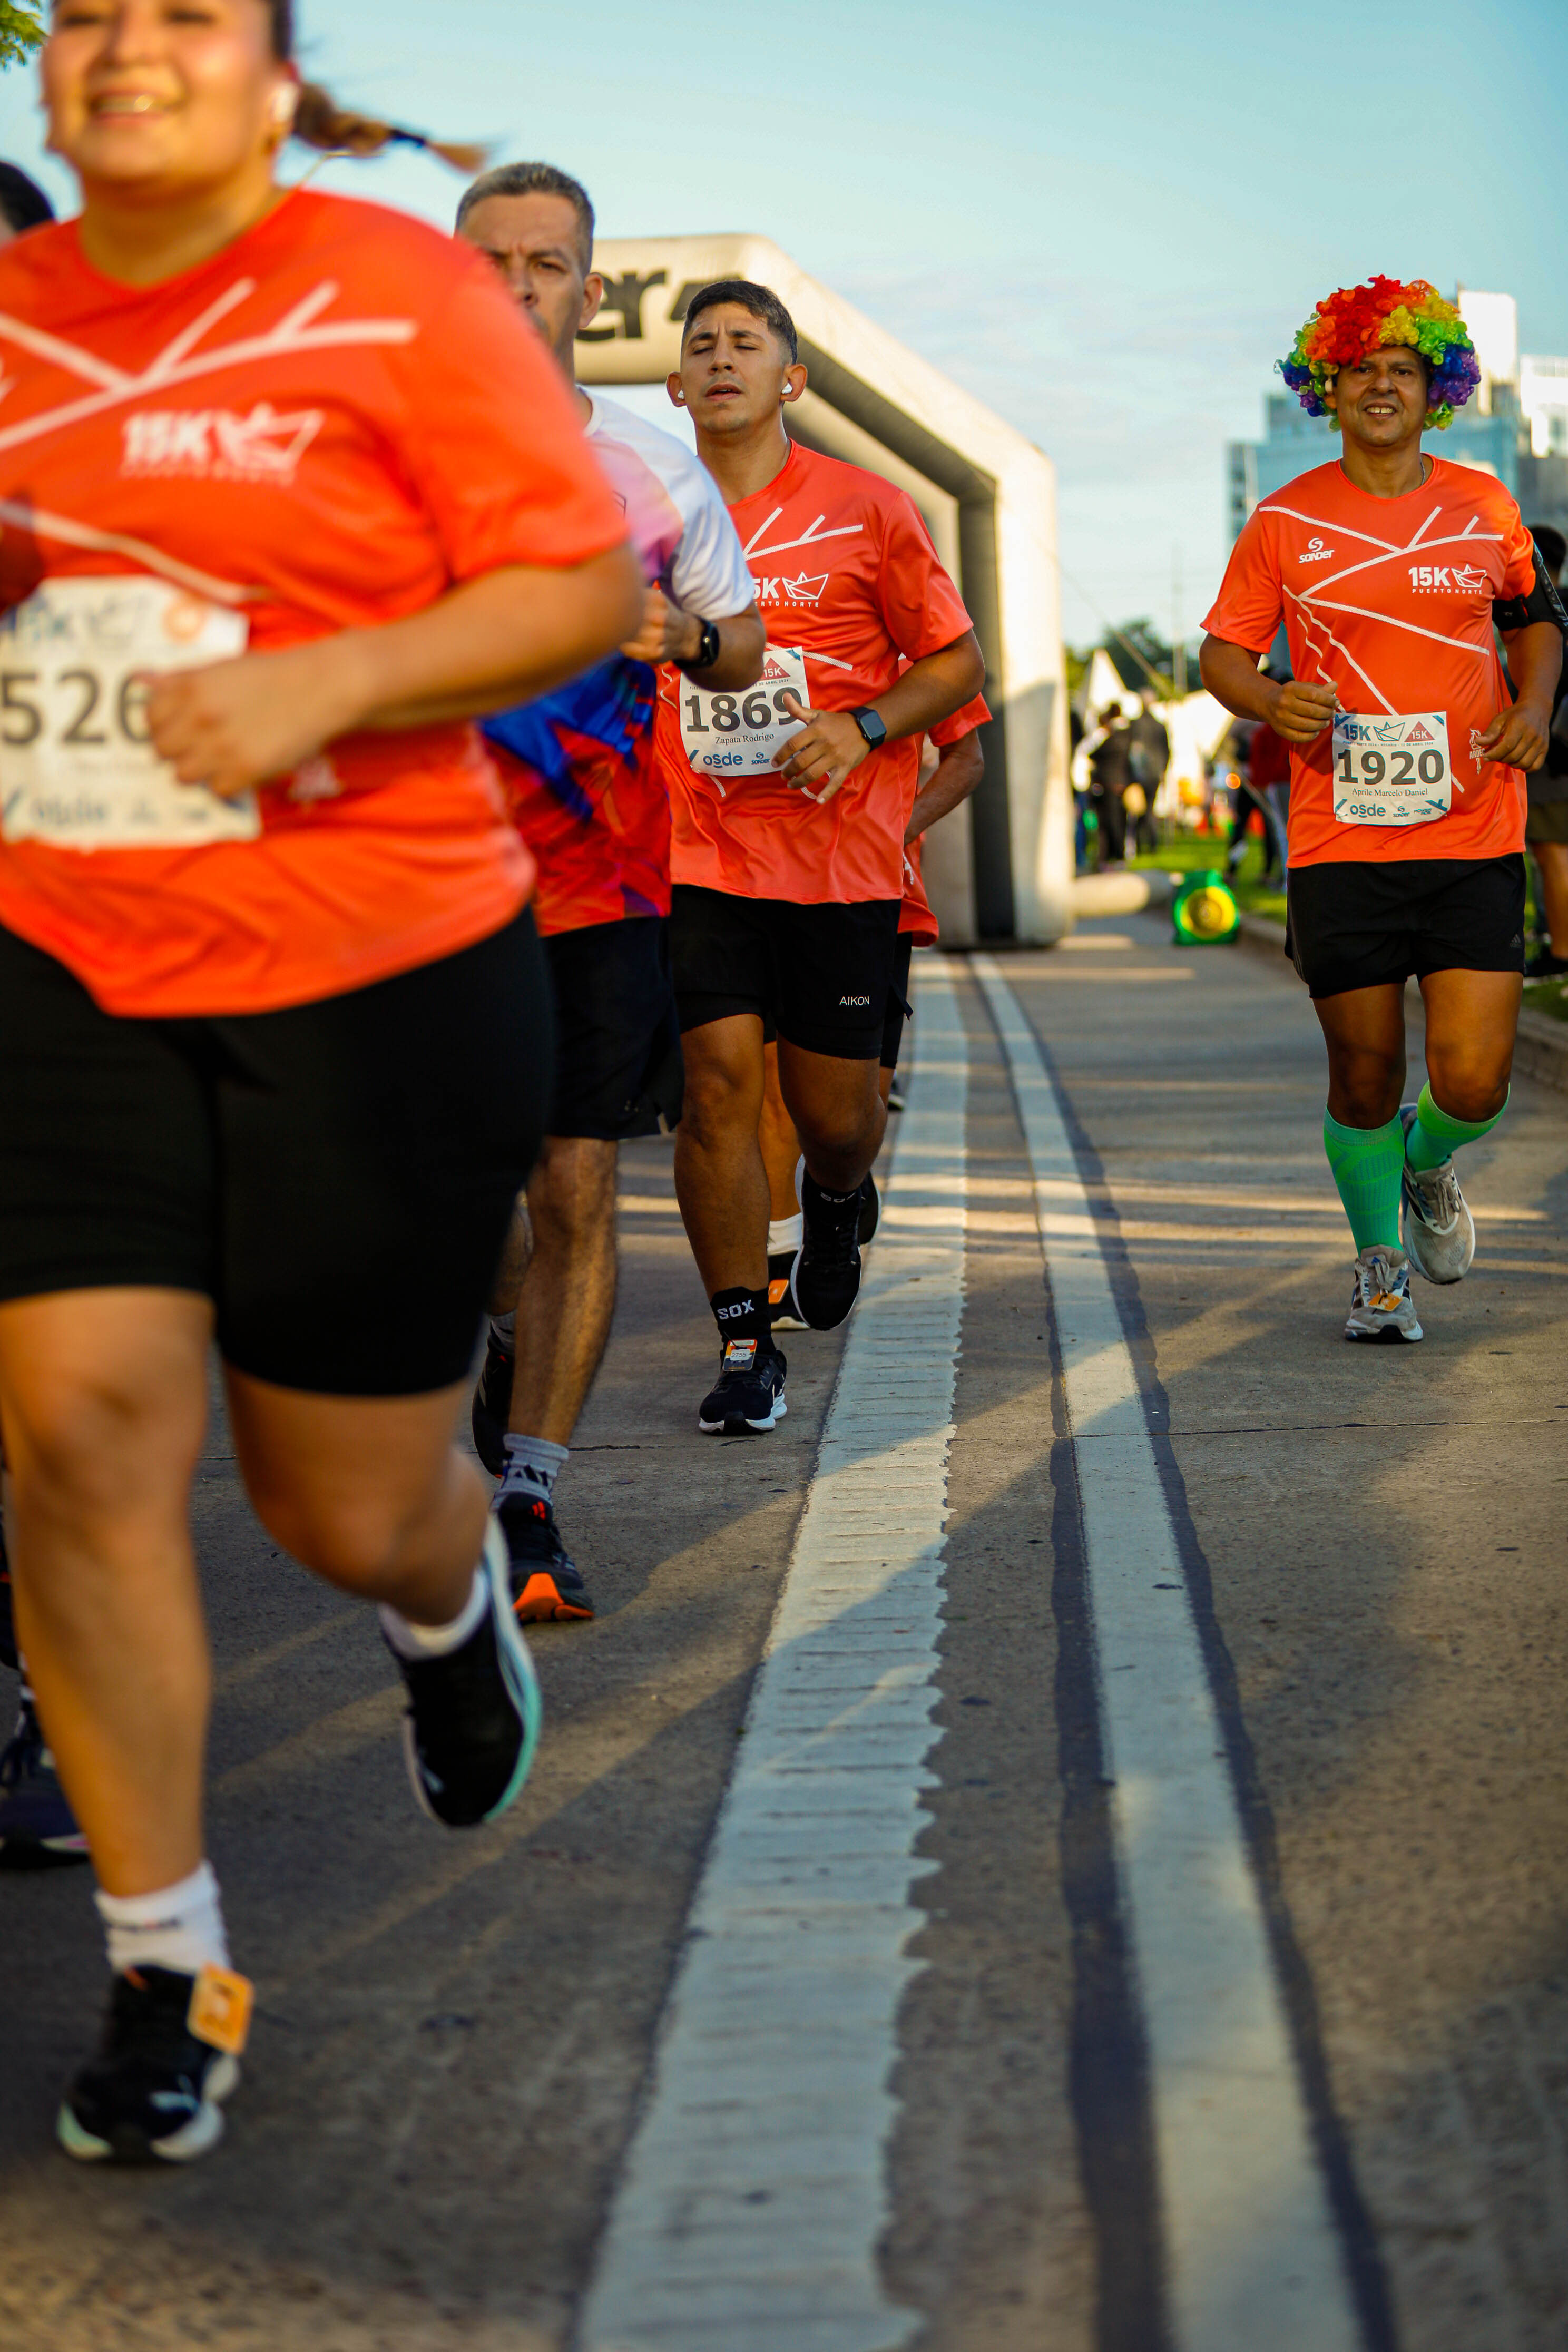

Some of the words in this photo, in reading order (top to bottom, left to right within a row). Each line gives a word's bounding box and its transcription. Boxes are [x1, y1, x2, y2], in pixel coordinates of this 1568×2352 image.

[1408, 567, 1451, 586] 15K
[752, 577, 780, 599] 5K
[685, 687, 802, 732] 1869
[715, 737, 741, 745] Zapata
[743, 733, 775, 742] Rodrigo
[1343, 724, 1371, 741] 15K
[1412, 731, 1428, 739] 15K
[703, 752, 743, 768] osde
[1338, 749, 1444, 785] 1920
[1352, 788, 1372, 797] Aprile
[1405, 788, 1428, 796] Daniel
[1350, 803, 1386, 817] osde
[839, 995, 869, 1005] AIKON
[717, 1299, 754, 1319] SOX
